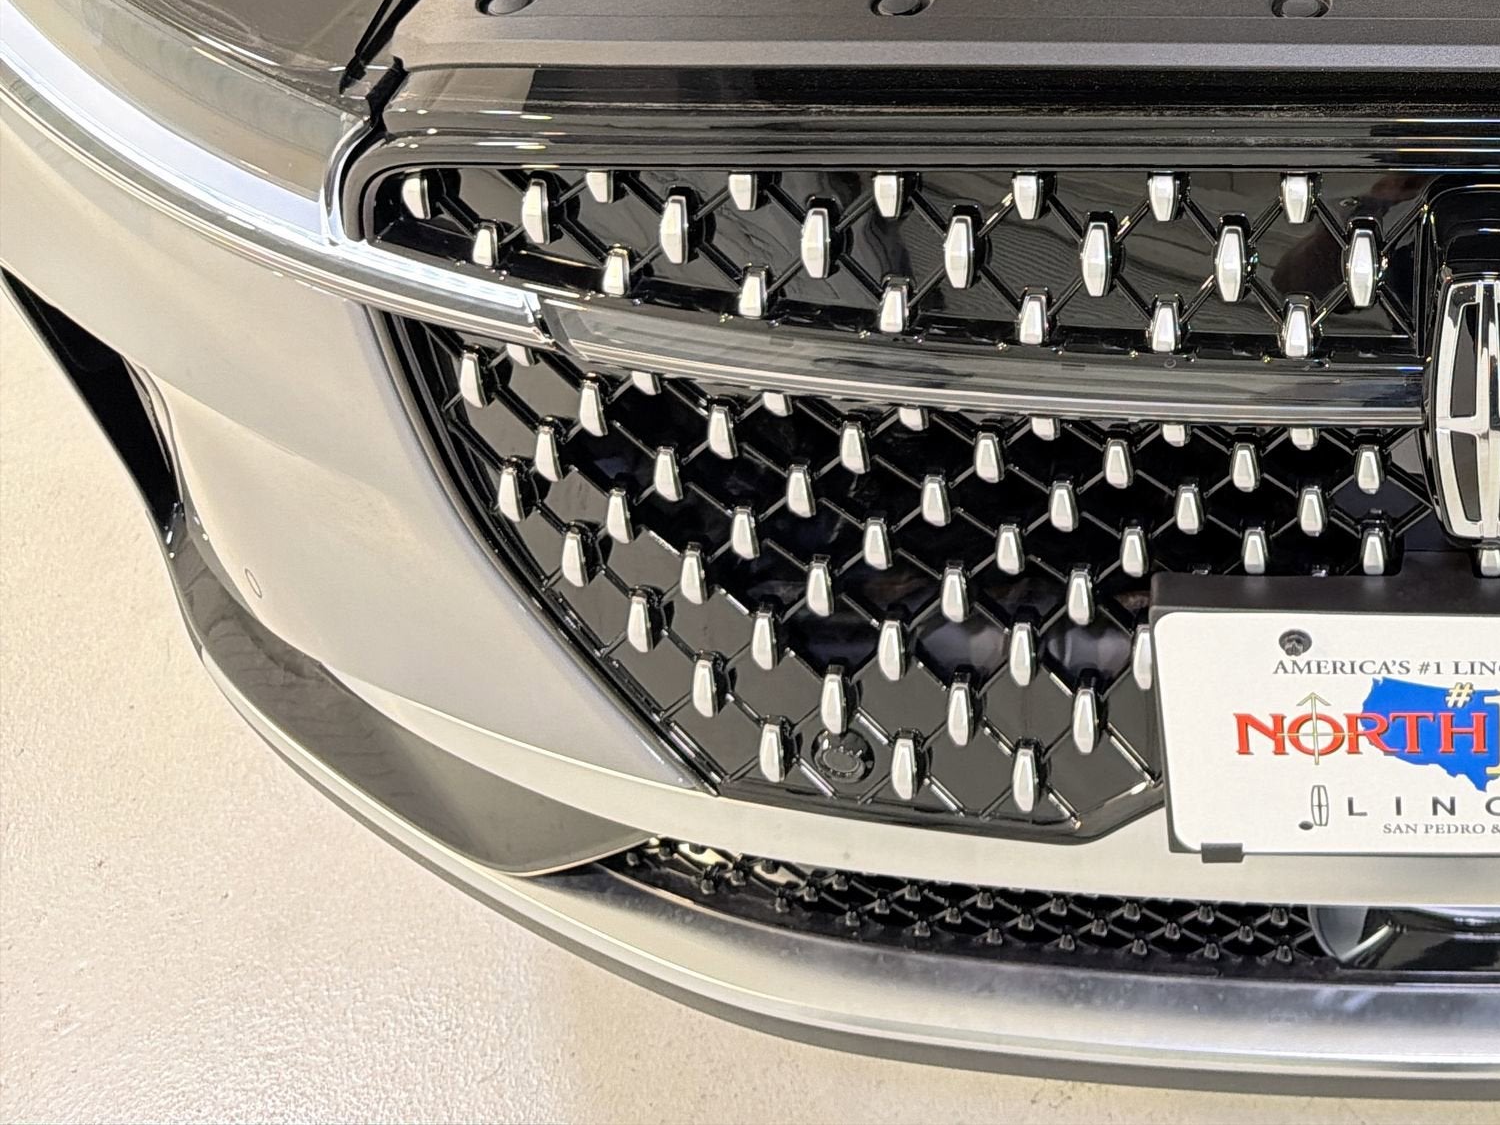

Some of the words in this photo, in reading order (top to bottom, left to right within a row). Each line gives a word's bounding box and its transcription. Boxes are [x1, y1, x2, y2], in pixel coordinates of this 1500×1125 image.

[1273, 660, 1410, 675] AMERICA'S
[1418, 661, 1444, 675] #1
[1233, 713, 1490, 756] NORTH
[1382, 823, 1418, 834] SAN
[1424, 823, 1486, 834] PEDRO
